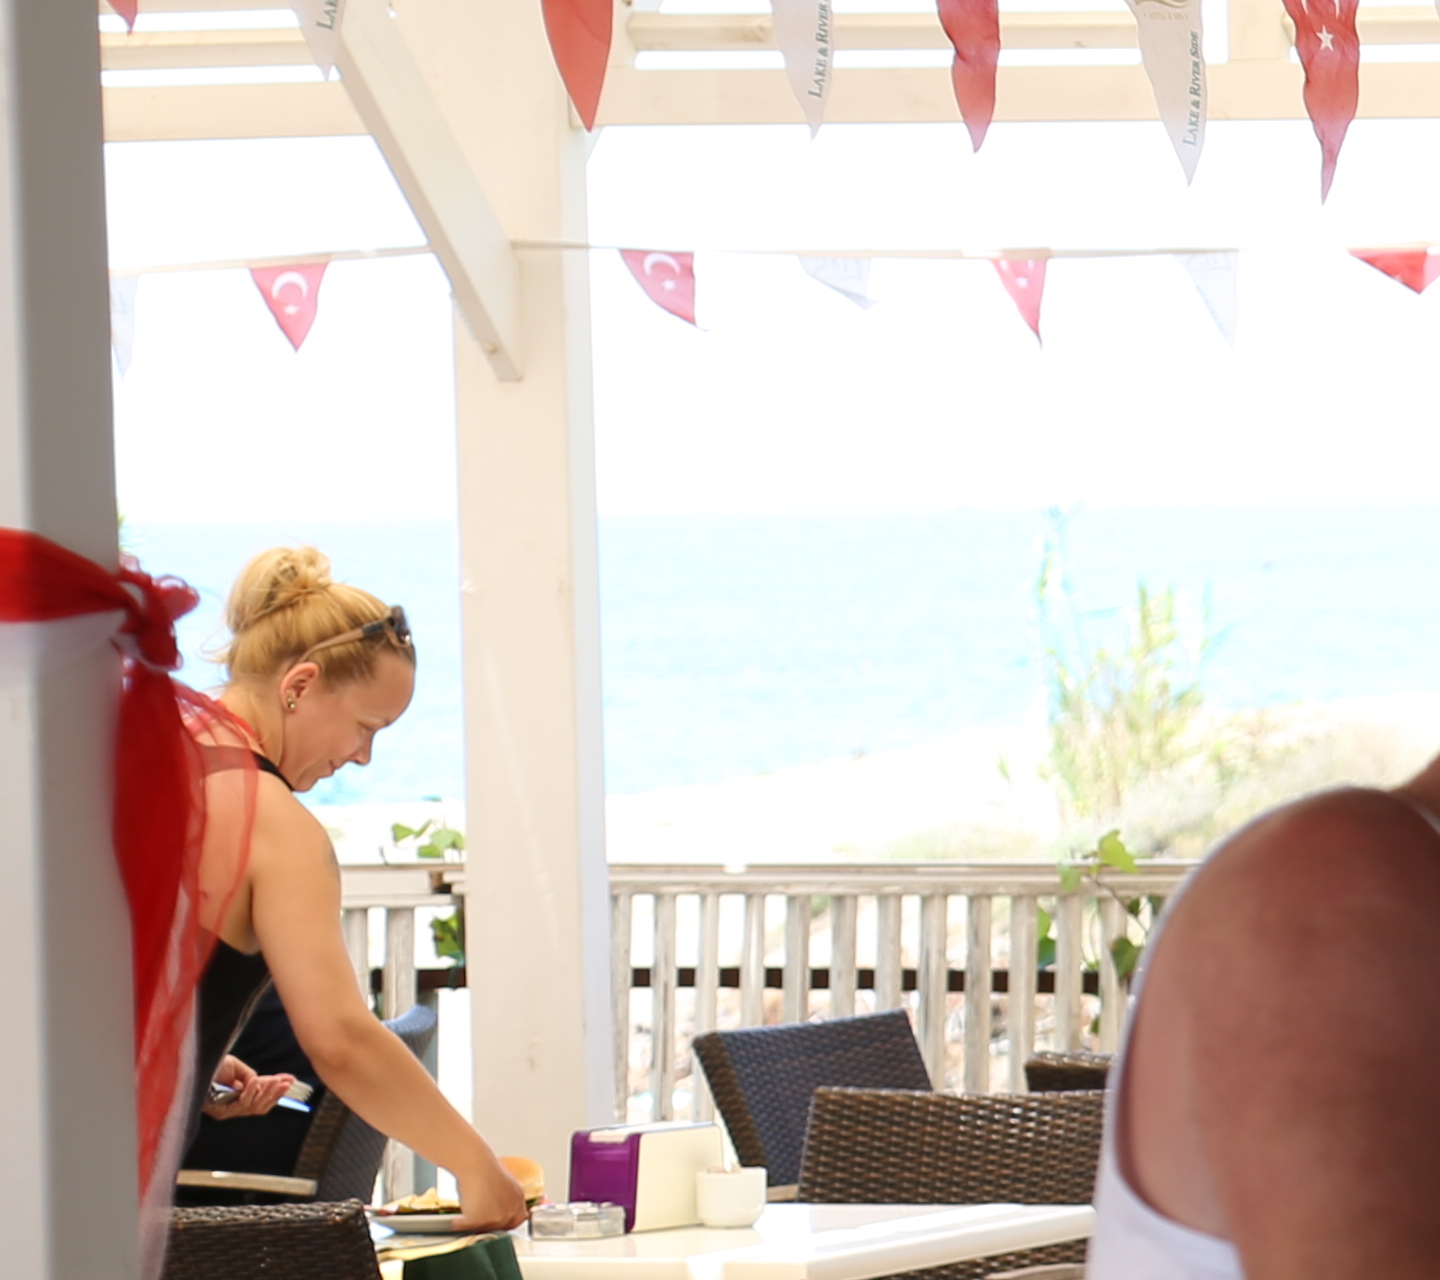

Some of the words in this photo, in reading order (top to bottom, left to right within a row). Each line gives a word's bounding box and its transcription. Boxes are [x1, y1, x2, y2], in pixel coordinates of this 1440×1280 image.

[815, 3, 830, 44] RIVER
[816, 44, 829, 58] &
[1189, 30, 1200, 58] SIDE
[807, 58, 829, 99] LAKE
[1188, 58, 1202, 97] RIVER
[1188, 95, 1201, 110] &
[1182, 109, 1201, 148] LAKE
